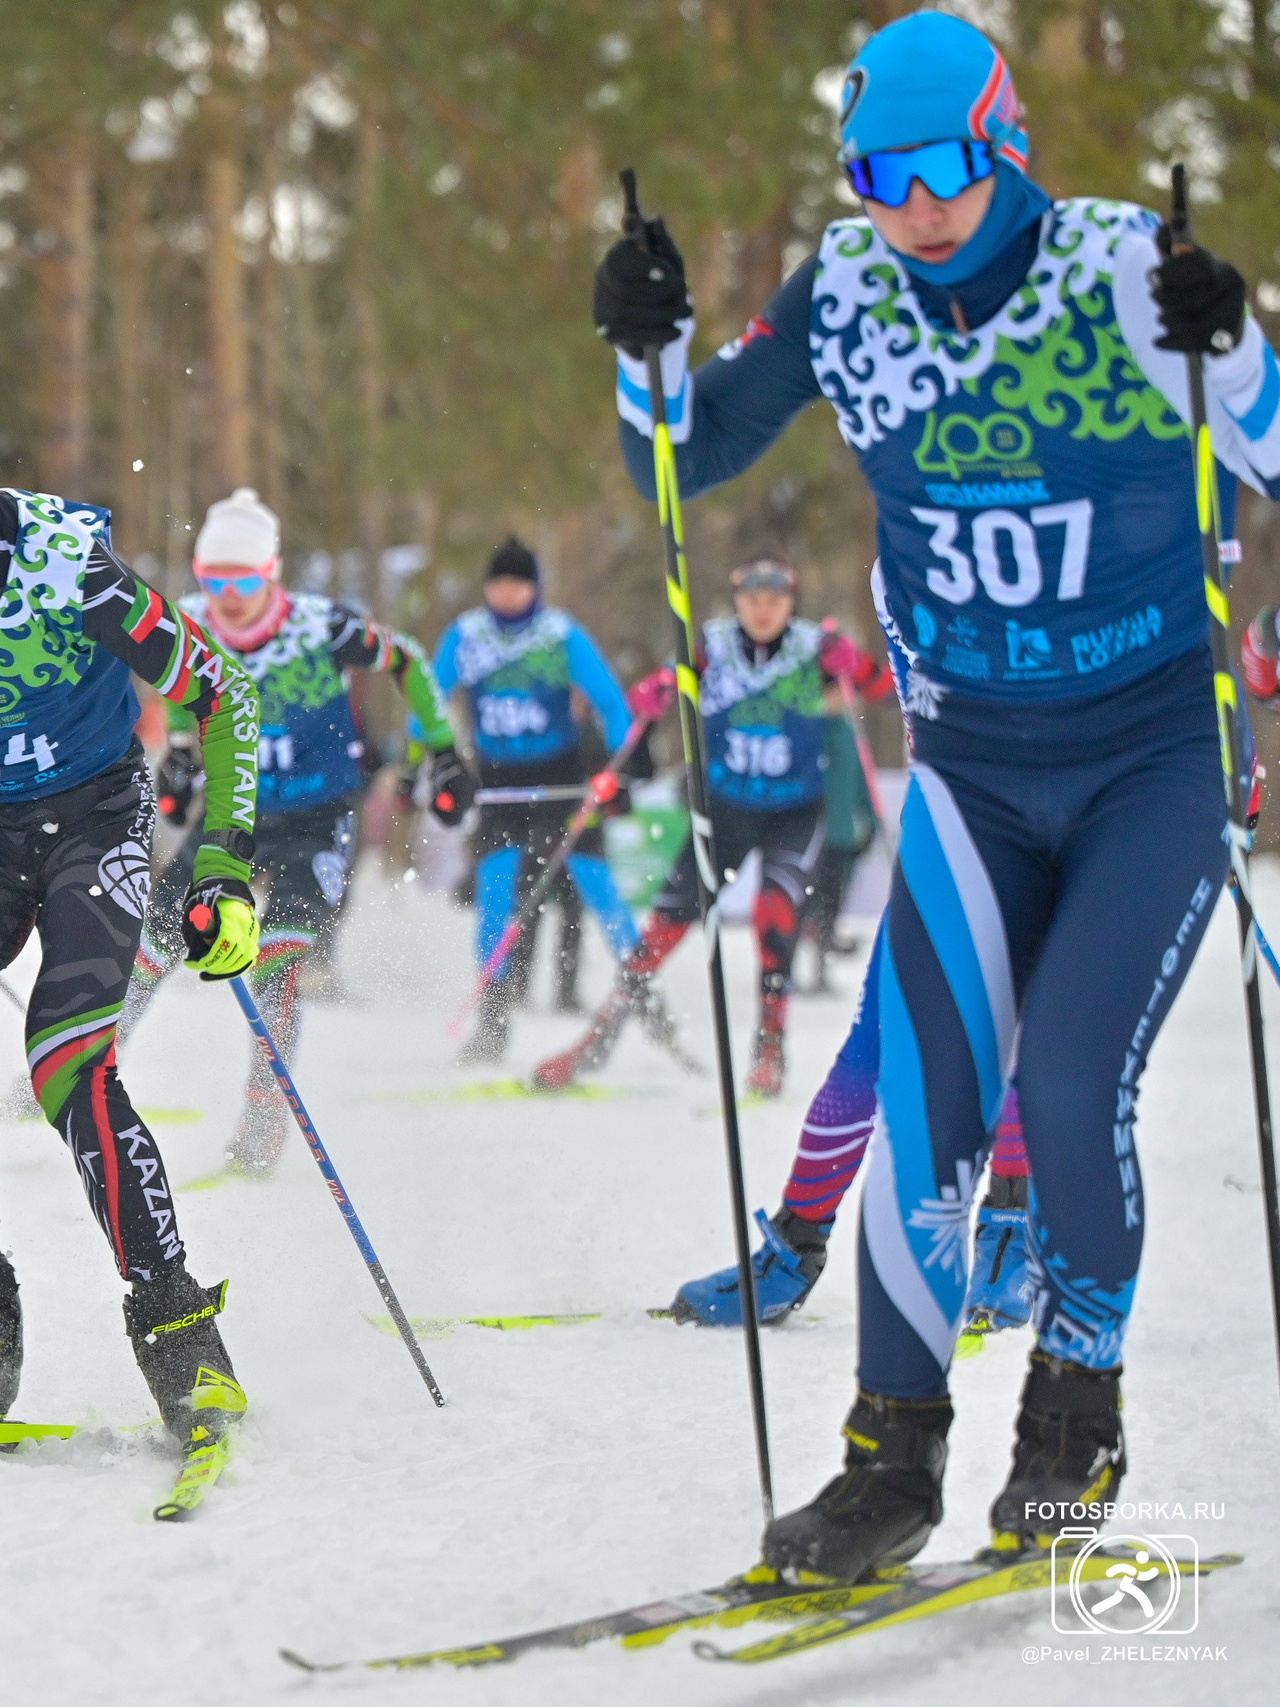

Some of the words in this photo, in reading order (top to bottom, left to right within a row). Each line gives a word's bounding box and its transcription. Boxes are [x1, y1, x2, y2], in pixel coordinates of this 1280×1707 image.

[910, 498, 1093, 606] 307
[184, 634, 260, 827] TATARSTAN
[116, 1123, 182, 1261] KAZAN
[990, 1212, 1029, 1224] SPIN
